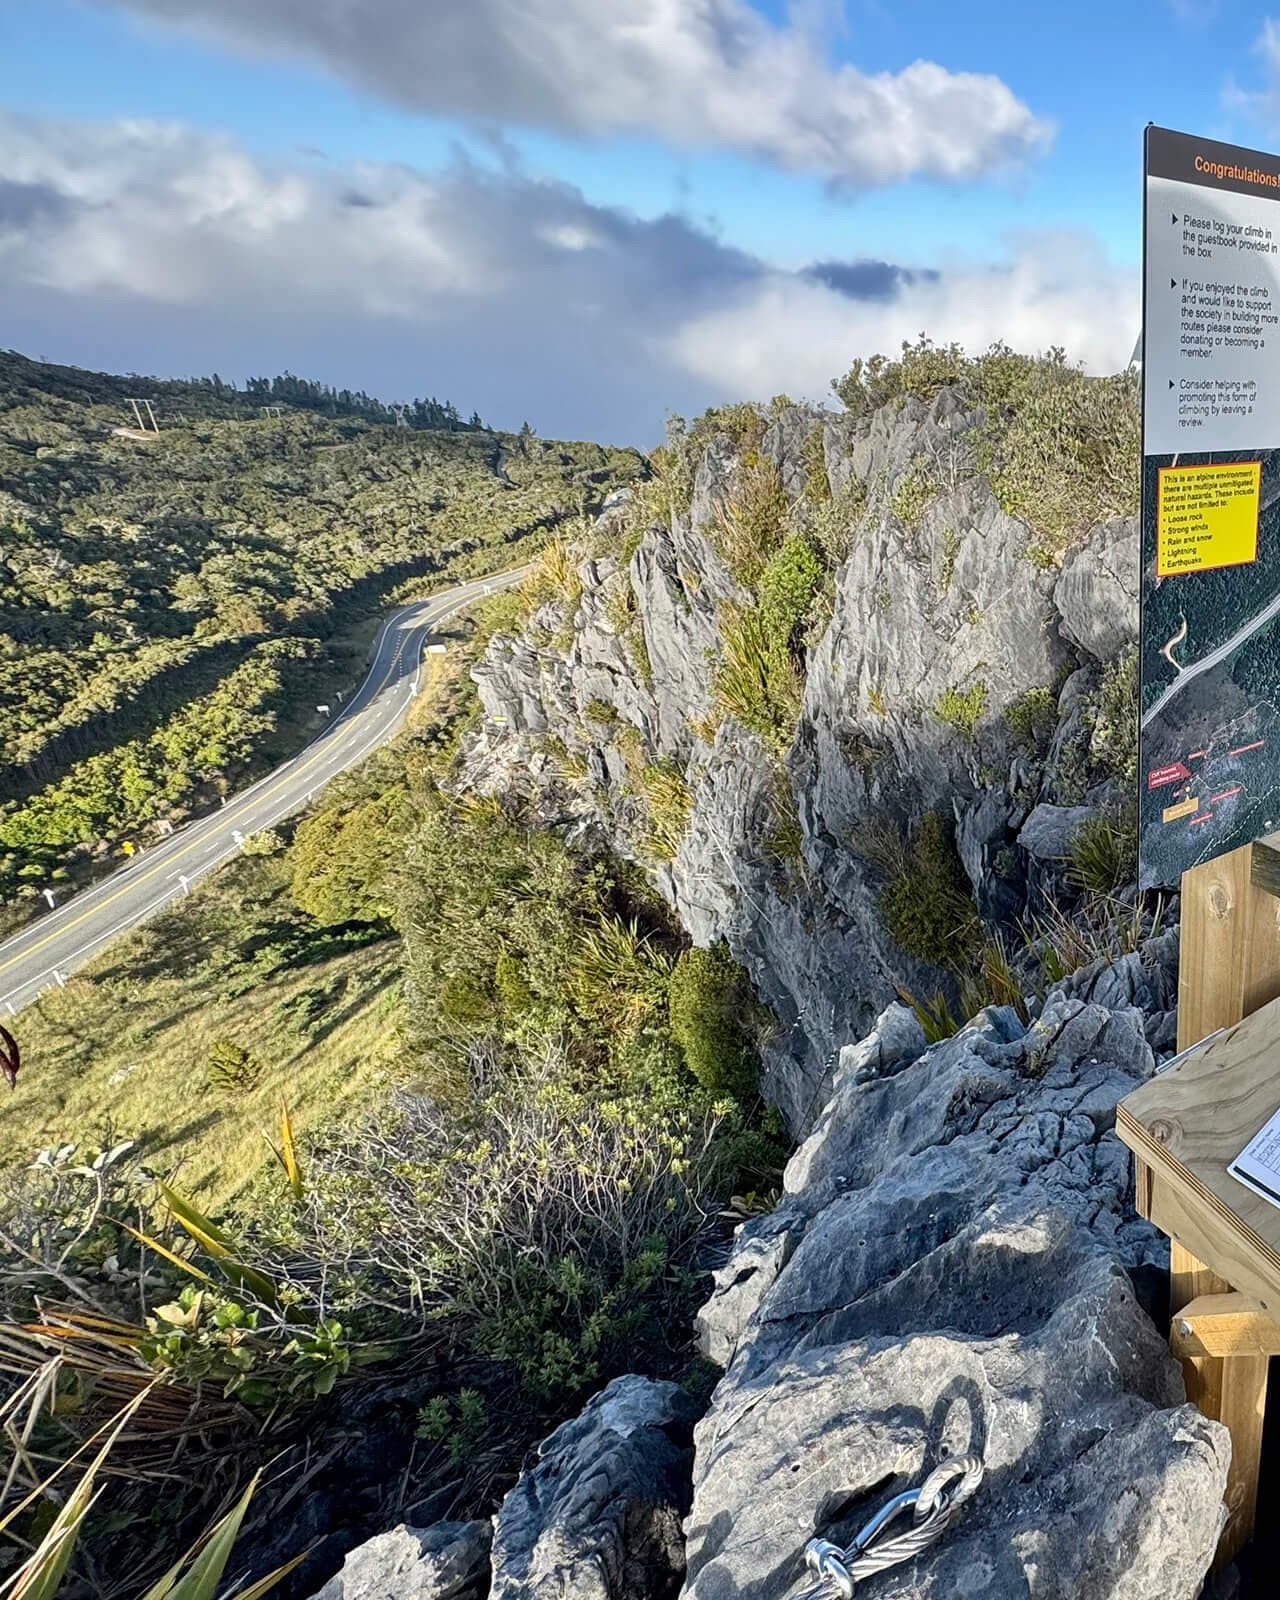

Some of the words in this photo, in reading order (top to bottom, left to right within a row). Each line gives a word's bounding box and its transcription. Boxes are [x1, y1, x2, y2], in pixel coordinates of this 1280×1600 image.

[1195, 156, 1280, 188] Congratulations!
[1184, 214, 1211, 230] Please
[1213, 220, 1224, 234] log
[1226, 223, 1244, 236] your
[1244, 225, 1264, 239] climb
[1266, 228, 1272, 240] in
[1182, 230, 1196, 242] the
[1198, 234, 1237, 248] guestbook
[1239, 240, 1270, 252] provided
[1271, 242, 1278, 254] in
[1182, 244, 1195, 256] the
[1182, 278, 1188, 290] If
[1190, 282, 1204, 293] you
[1205, 282, 1236, 296] enjoyed
[1236, 286, 1248, 296] the
[1250, 286, 1268, 298] climb
[1181, 294, 1196, 304] and
[1198, 296, 1220, 306] would
[1222, 296, 1236, 308] like
[1236, 298, 1244, 308] to
[1246, 300, 1272, 312] support
[1181, 306, 1194, 318] the
[1196, 308, 1222, 322] society
[1224, 309, 1230, 320] in
[1232, 310, 1260, 325] building
[1261, 314, 1278, 324] more
[1181, 322, 1205, 332] routes
[1206, 322, 1232, 334] please
[1232, 325, 1263, 336] consider
[1180, 334, 1213, 348] donating
[1214, 337, 1223, 346] or
[1224, 336, 1258, 350] becoming
[1260, 339, 1264, 348] a
[1180, 378, 1214, 390] Consider
[1215, 380, 1240, 392] helping
[1242, 380, 1256, 390] with
[1178, 392, 1216, 404] promoting
[1217, 392, 1230, 402] this
[1232, 392, 1248, 402] form
[1249, 392, 1256, 402] of
[1178, 404, 1210, 416] climbing
[1211, 405, 1220, 416] by
[1222, 404, 1246, 416] leaving
[1248, 406, 1252, 414] a
[1164, 475, 1178, 484] This
[1187, 474, 1194, 482] an
[1196, 473, 1214, 482] alpine
[1216, 470, 1252, 480] environment
[1164, 485, 1180, 493] there
[1194, 482, 1218, 490] multiple
[1220, 479, 1253, 489] unmitigated
[1164, 494, 1186, 502] natural
[1215, 489, 1232, 498] These
[1234, 488, 1254, 496] include
[1164, 504, 1174, 512] but
[1187, 502, 1198, 510] not
[1199, 500, 1220, 508] limited
[1168, 515, 1188, 524] Loose
[1168, 526, 1189, 535] Strong
[1190, 523, 1208, 532] winds
[1168, 538, 1182, 546] Rain
[1184, 536, 1195, 544] and
[1196, 534, 1212, 542] snow
[1168, 548, 1197, 558] Lightning
[1167, 558, 1202, 568] Earthquake
